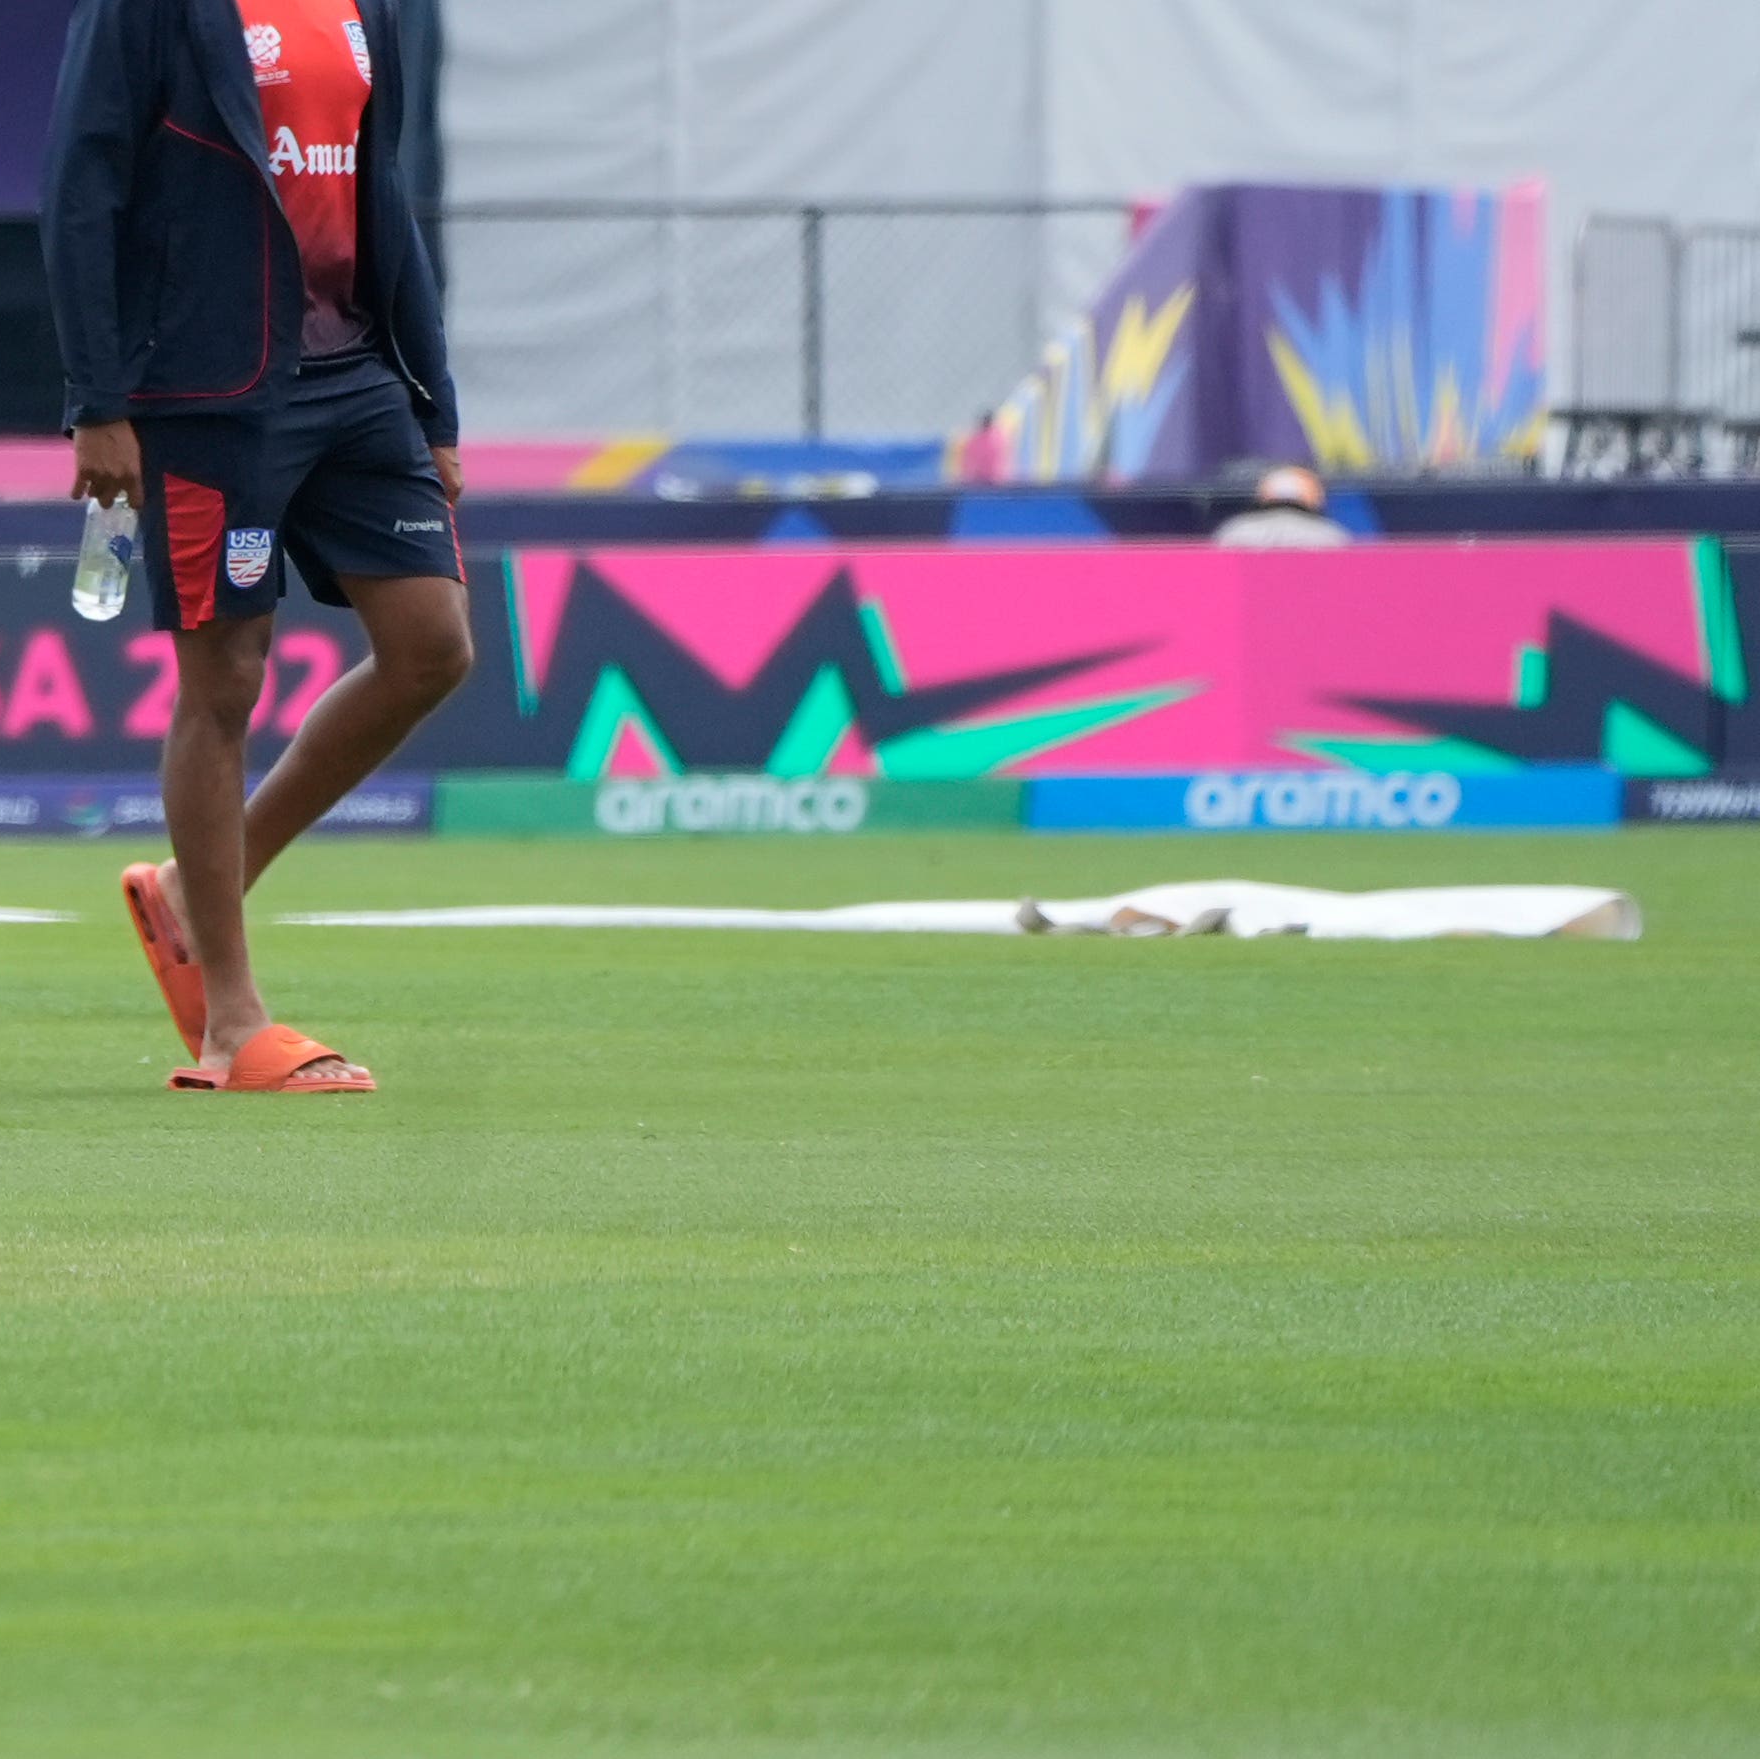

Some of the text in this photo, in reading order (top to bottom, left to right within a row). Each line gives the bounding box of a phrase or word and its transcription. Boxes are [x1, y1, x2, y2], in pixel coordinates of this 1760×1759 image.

[230, 530, 271, 549] USA
[595, 776, 868, 832] aramco
[1184, 770, 1461, 827] aramco
